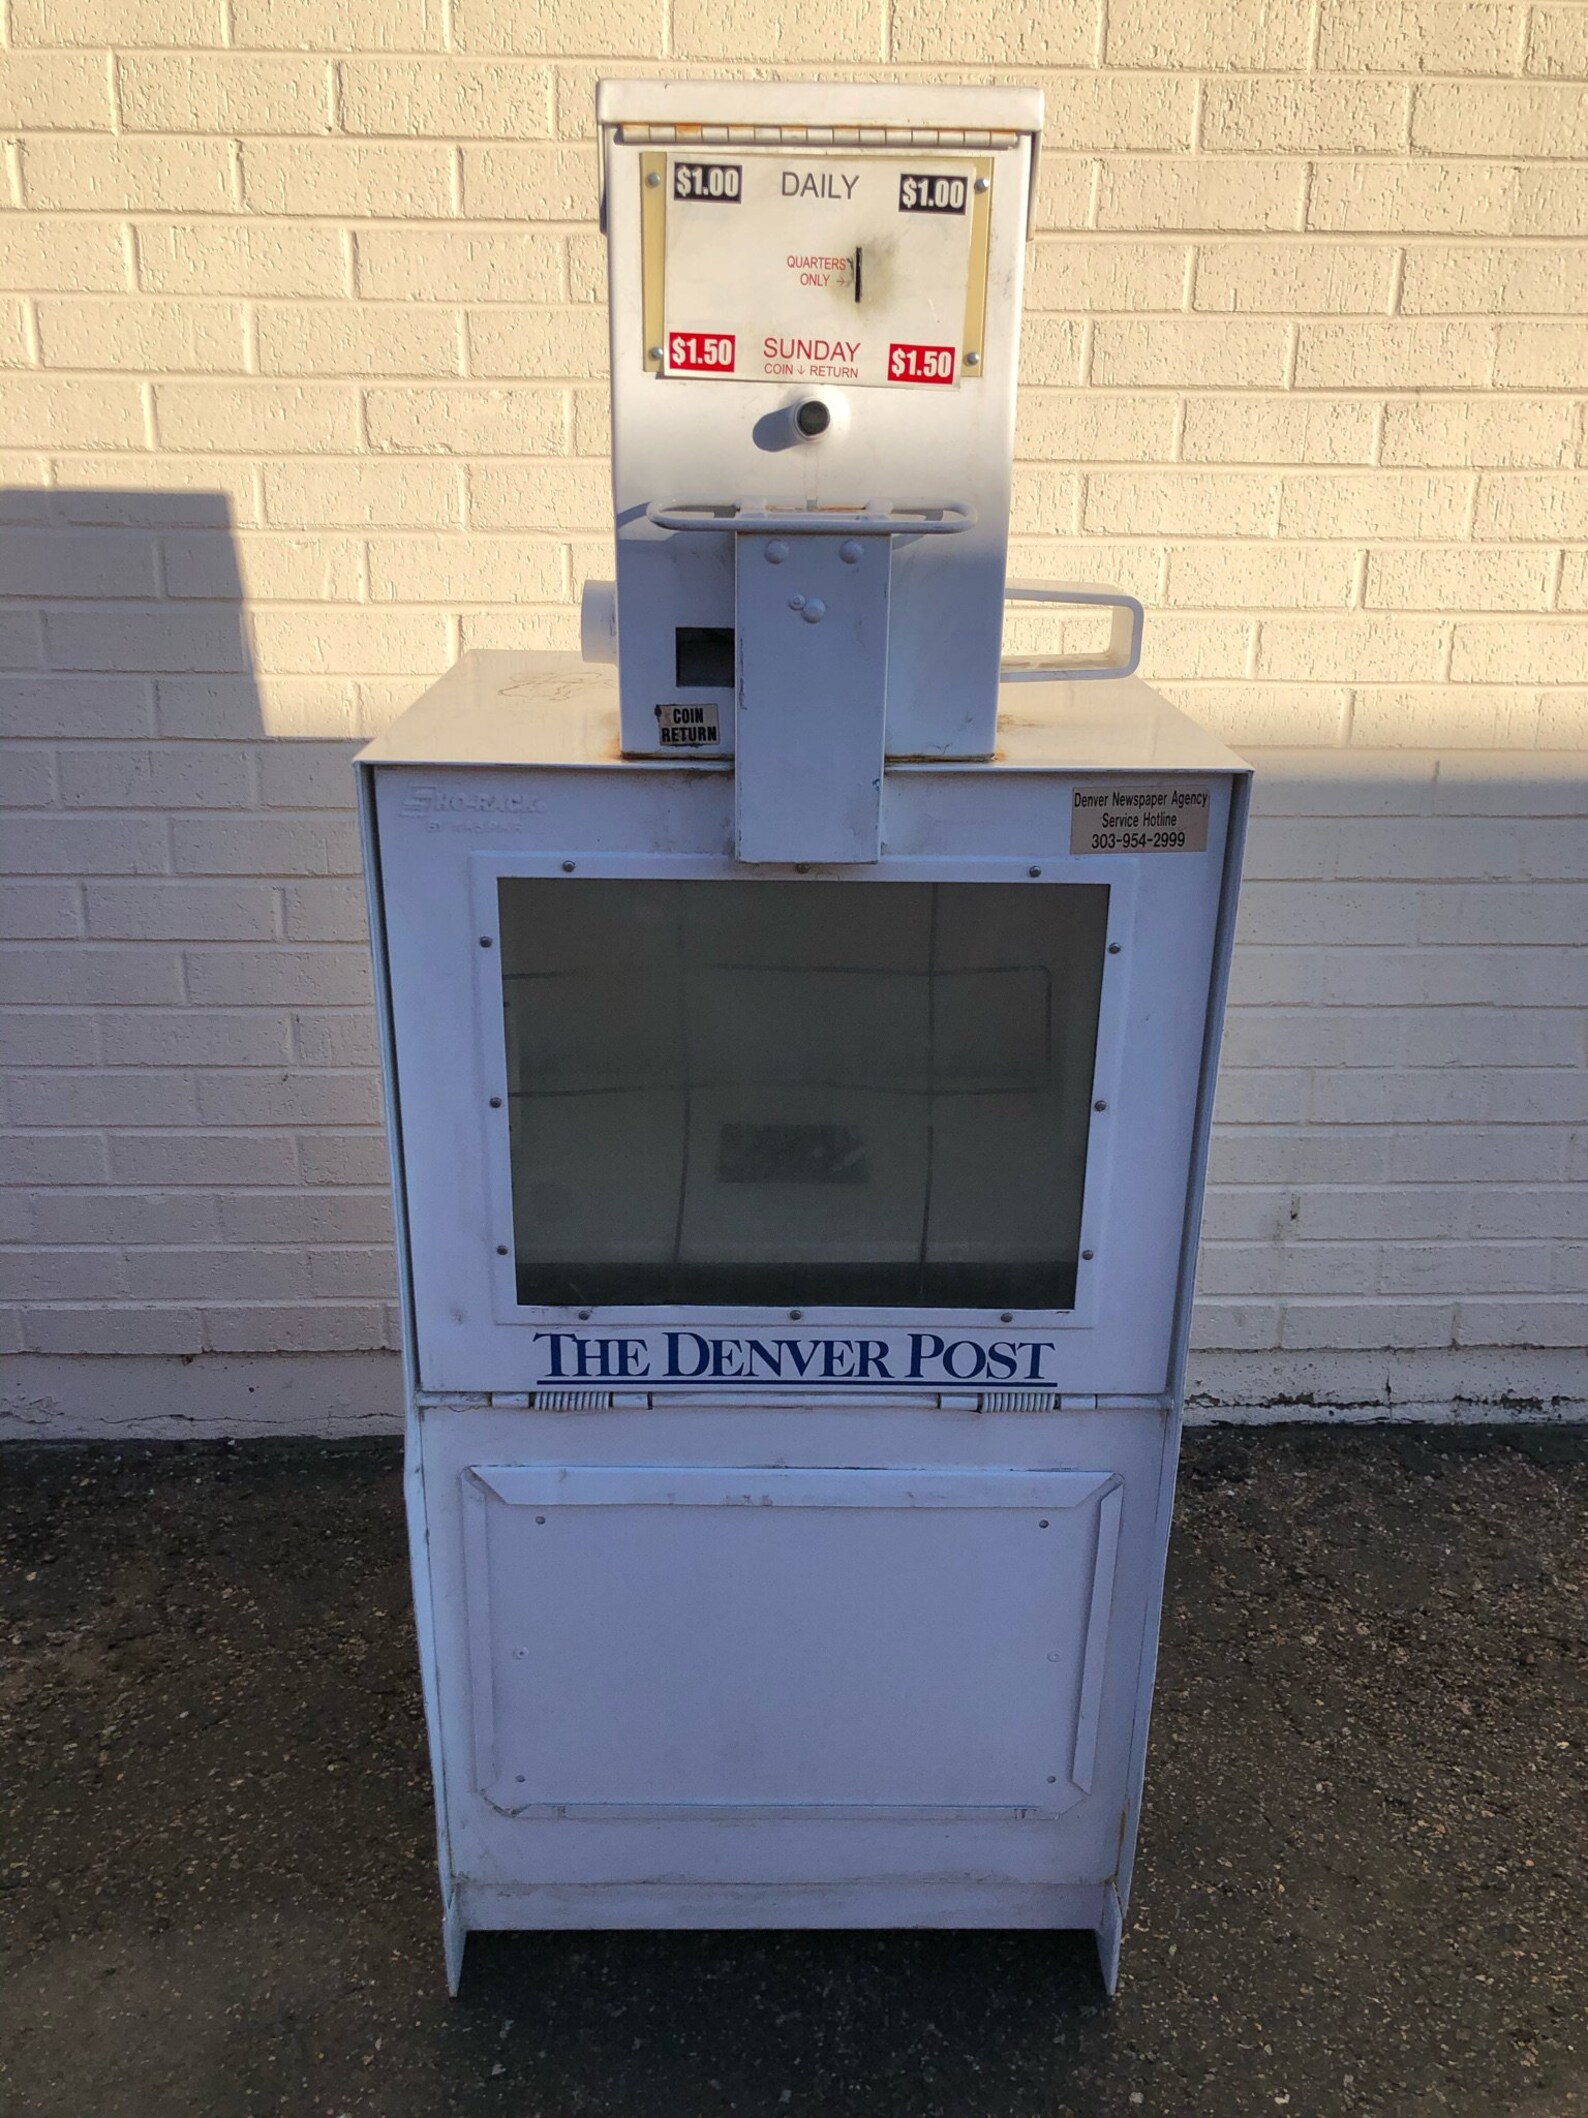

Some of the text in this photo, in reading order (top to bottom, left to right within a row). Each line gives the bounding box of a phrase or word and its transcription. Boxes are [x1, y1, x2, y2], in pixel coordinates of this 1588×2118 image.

[675, 165, 740, 198] $1.00
[780, 171, 860, 200] DAILY
[901, 176, 965, 209] $1.00
[786, 255, 847, 271] QUARTERS
[799, 272, 830, 287] ONLY
[671, 336, 733, 367] $1.50
[763, 337, 861, 362] SUNDAY
[763, 362, 859, 379] COIN RETURN
[890, 347, 953, 379] $1.50
[672, 707, 704, 724] COIN
[661, 726, 717, 742] RETURN
[1074, 790, 1209, 809] Denver Newspaper Agency
[1101, 811, 1178, 828] Service Hotline
[1091, 832, 1186, 849] 303-954-2999
[532, 1332, 1056, 1380] THE DENVER POST
